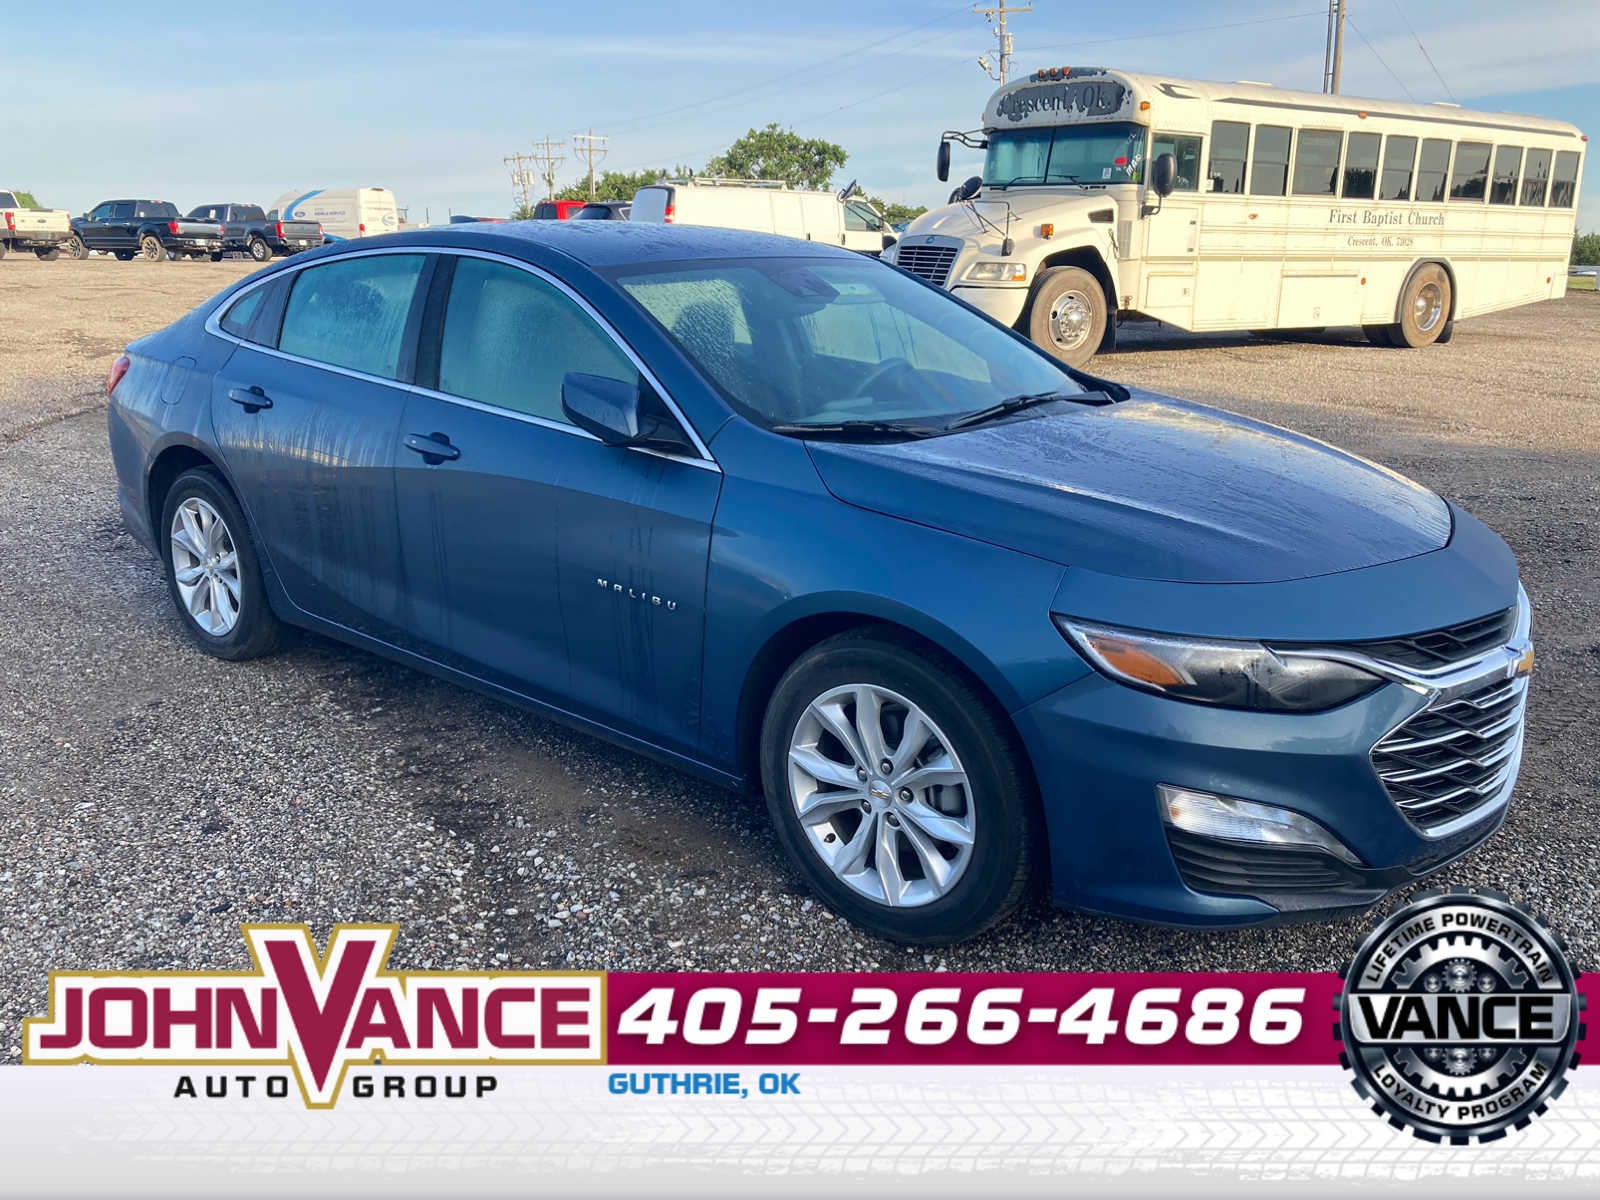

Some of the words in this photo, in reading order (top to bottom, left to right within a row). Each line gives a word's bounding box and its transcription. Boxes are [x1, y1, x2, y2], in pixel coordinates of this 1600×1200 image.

[1329, 209, 1357, 224] First
[1363, 209, 1402, 226] Baptist
[1407, 209, 1445, 225] Church
[597, 578, 676, 610] MALIBU
